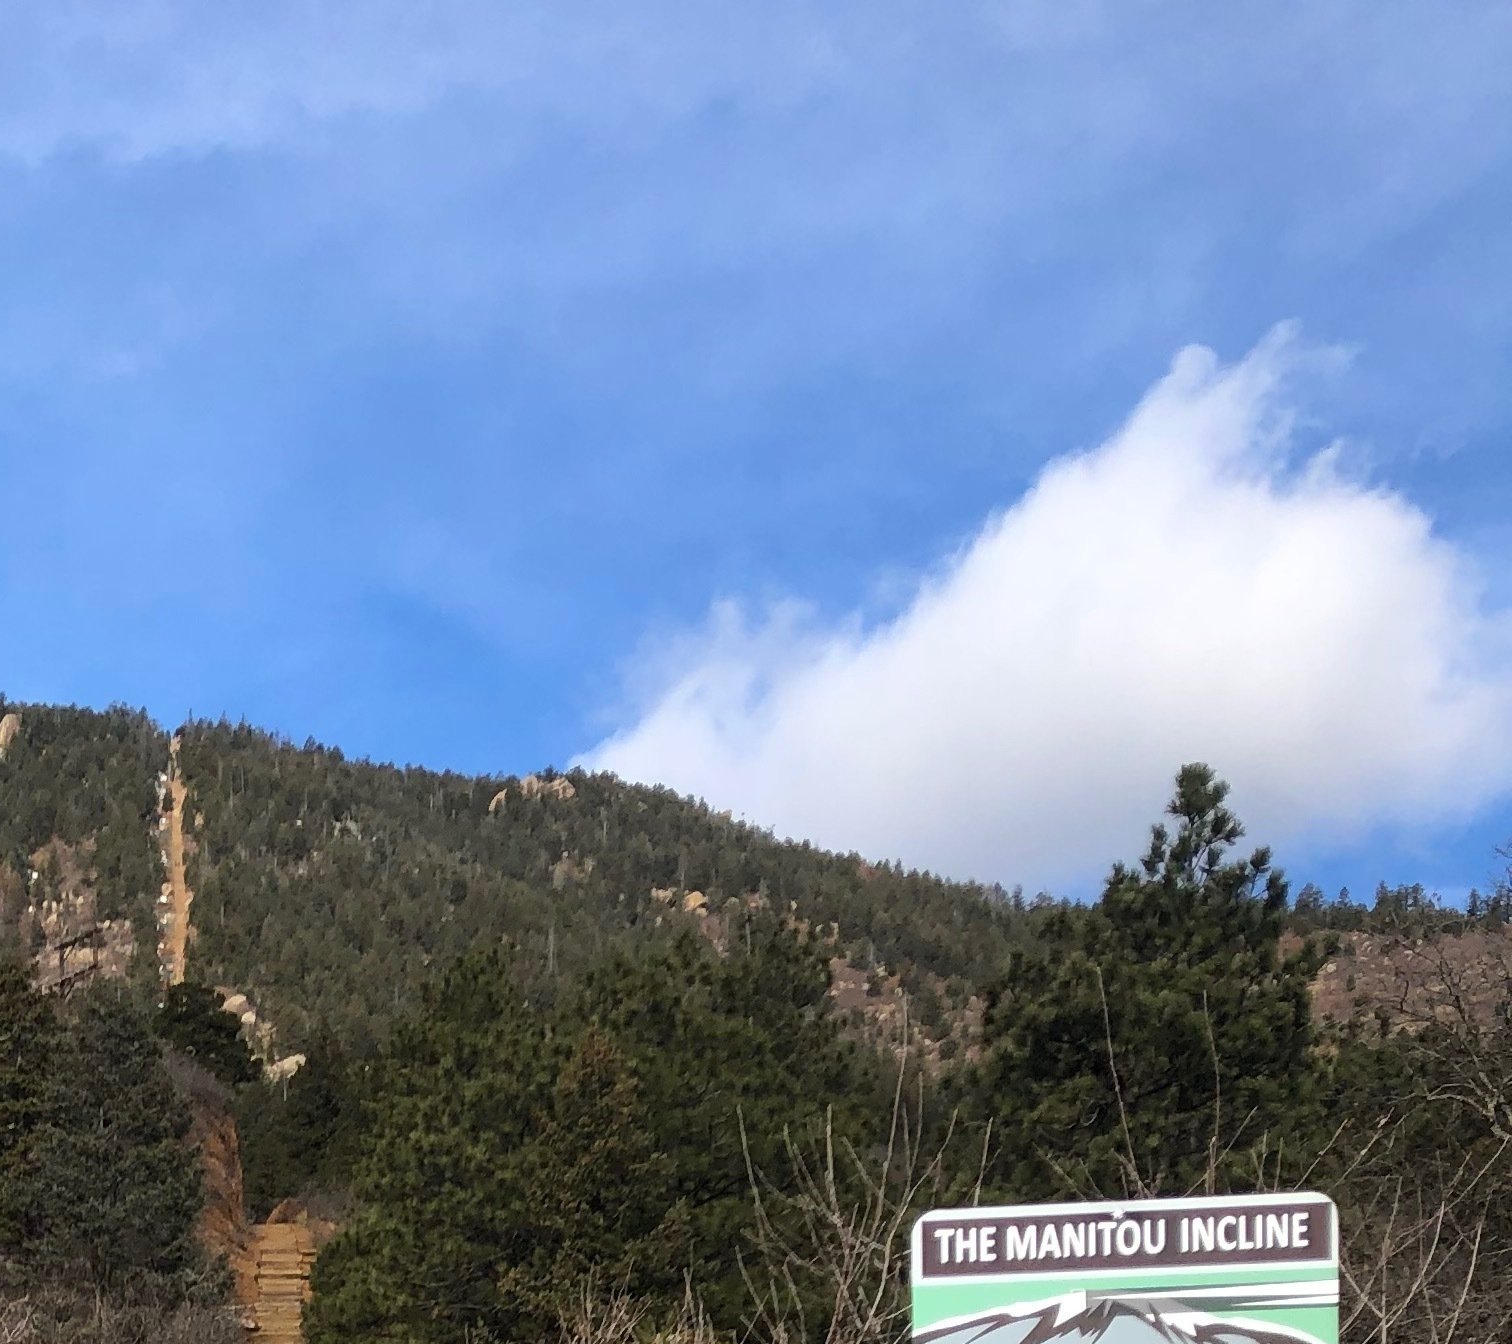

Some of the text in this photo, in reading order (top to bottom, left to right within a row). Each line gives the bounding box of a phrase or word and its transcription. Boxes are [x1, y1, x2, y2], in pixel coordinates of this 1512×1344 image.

[934, 1211, 1310, 1265] THE MANITOU INCLINE
